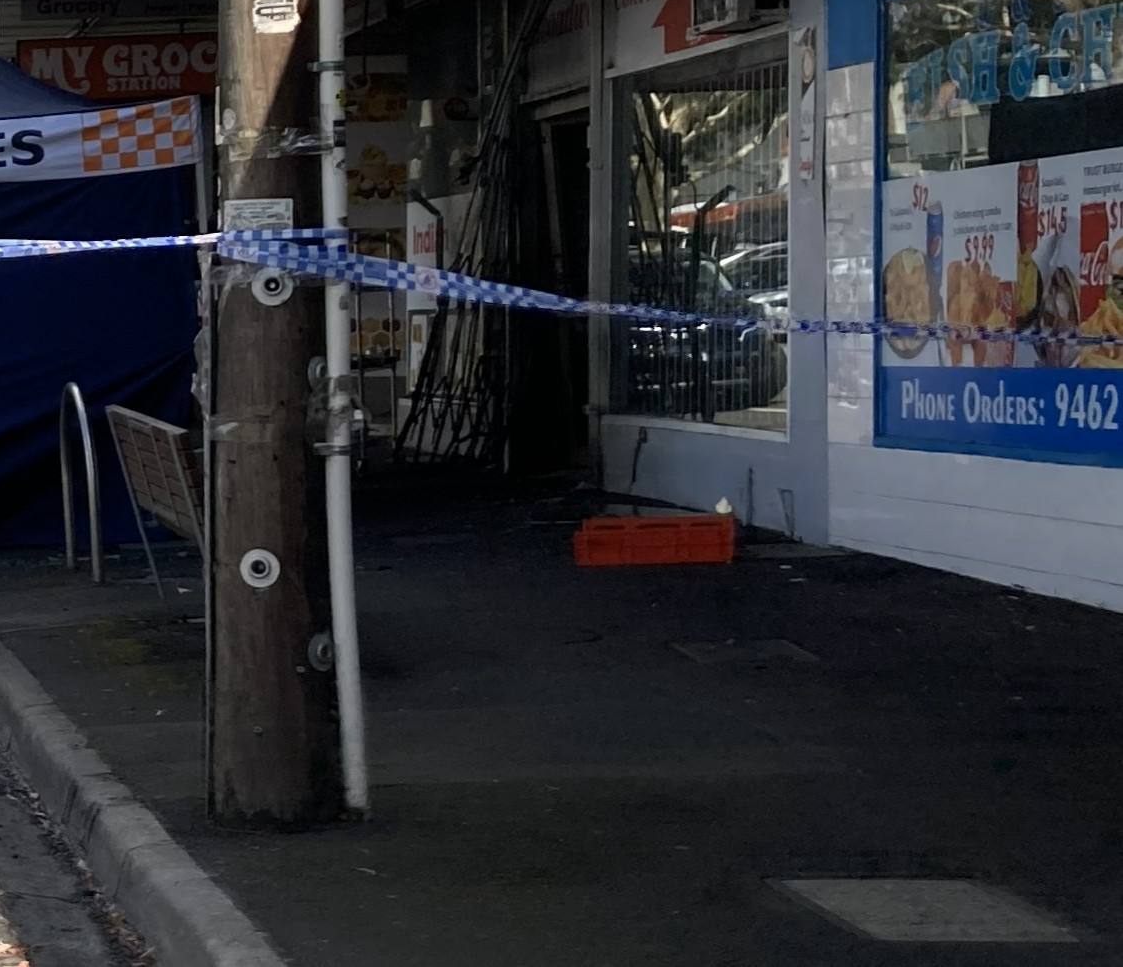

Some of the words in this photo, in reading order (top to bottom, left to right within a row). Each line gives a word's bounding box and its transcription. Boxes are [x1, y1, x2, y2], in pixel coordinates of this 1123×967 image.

[30, 45, 97, 95] MY
[102, 41, 219, 77] GROC
[1049, 1, 1123, 91] CH
[106, 75, 181, 93] STATION
[1055, 383, 1119, 430] 9462
